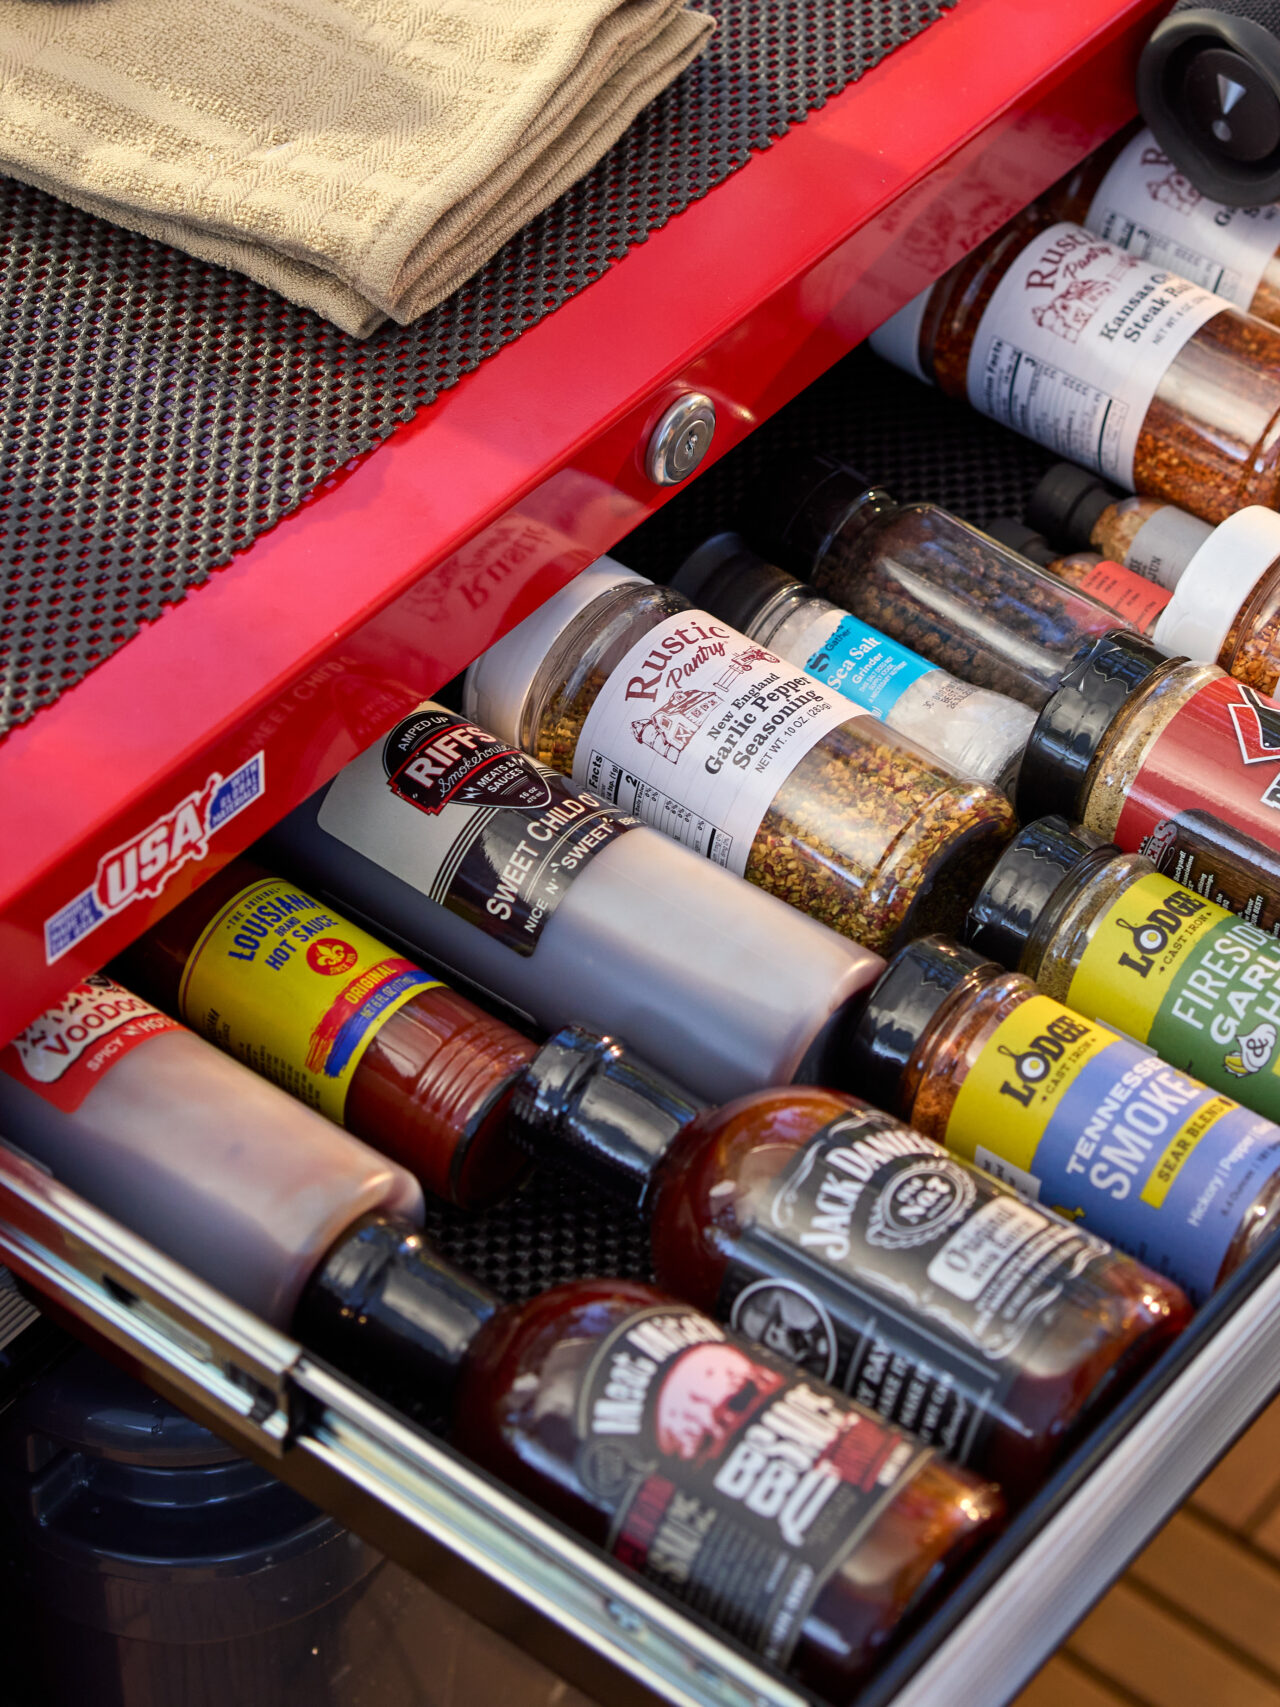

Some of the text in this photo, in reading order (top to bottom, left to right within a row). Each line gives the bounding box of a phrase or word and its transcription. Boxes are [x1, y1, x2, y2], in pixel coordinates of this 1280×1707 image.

[1100, 284, 1156, 342] Kansas
[1124, 296, 1170, 342] Steak
[625, 621, 730, 703] Rustic
[825, 627, 851, 651] Gather
[827, 637, 881, 690] Sea Salt
[666, 642, 726, 690] Pantry
[852, 653, 883, 684] Grinder
[705, 676, 812, 775] Garlic Pepper
[707, 672, 781, 741] New England
[732, 690, 824, 771] Seasoning
[398, 716, 449, 751] AMPED UP
[404, 726, 498, 789] RIFFS
[755, 702, 832, 774] NET WT. 10 OZ. (283g)
[438, 744, 511, 798] Smokehouse
[477, 760, 516, 788] MEATS &
[487, 767, 524, 793] SAUCES
[519, 786, 539, 800] 16 oz
[588, 755, 603, 789] Facts
[625, 774, 637, 788] 2
[106, 802, 203, 906] USA
[486, 840, 539, 921] SWEET
[526, 798, 586, 842] CHILD
[228, 889, 278, 926] THE ORIGINAL
[228, 894, 322, 962] LOUISIANA
[274, 917, 301, 937] BRAND
[524, 898, 549, 933] NICE
[265, 915, 339, 971] HOT SAUCE
[1116, 890, 1207, 979] LODGE
[1163, 914, 1208, 965] CAST IRON
[345, 964, 397, 1005] ORIGINAL
[1171, 921, 1278, 1030] FIRESIDE
[43, 997, 150, 1056] VOODOO
[360, 1003, 377, 1019] NET
[87, 1037, 125, 1071] SPICY
[997, 1014, 1092, 1108] LODGE
[1046, 1041, 1092, 1094] CAST IRON
[1246, 1037, 1270, 1059] &
[1089, 1071, 1201, 1201] SMOKE
[1157, 1102, 1226, 1183] SEAR BLEND
[800, 1172, 866, 1261] JACK
[1187, 1174, 1225, 1227] Hickory
[592, 1354, 656, 1434] Meat
[713, 1446, 841, 1548] BBQ
